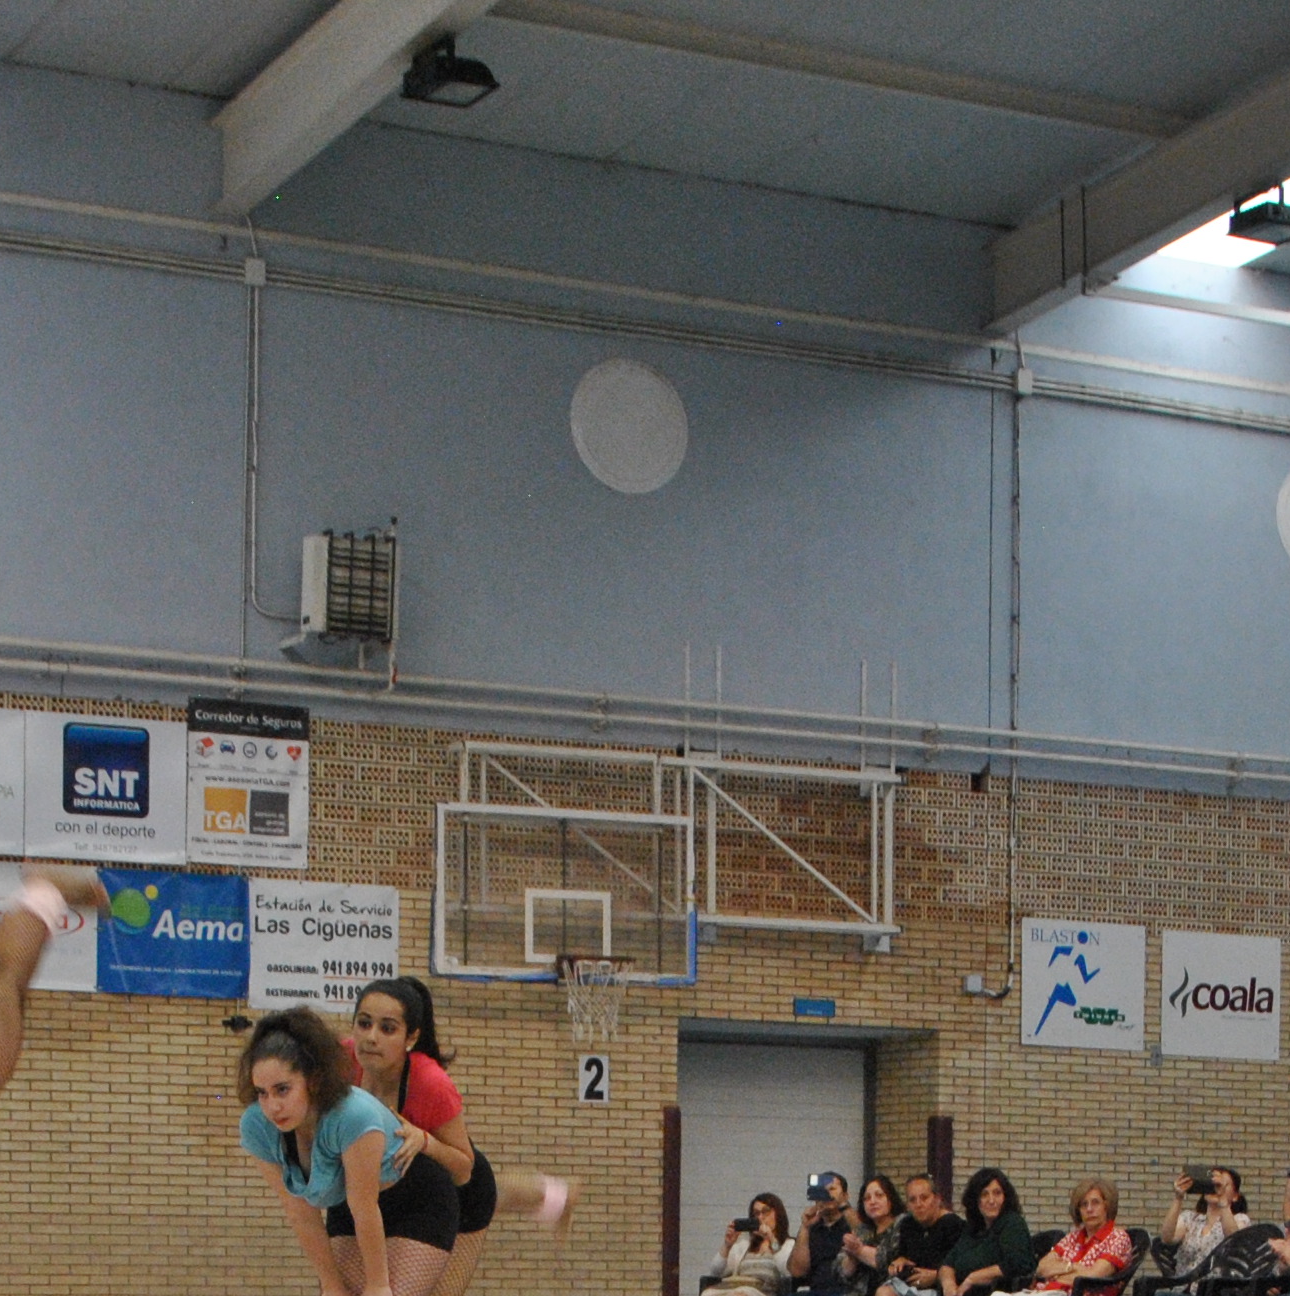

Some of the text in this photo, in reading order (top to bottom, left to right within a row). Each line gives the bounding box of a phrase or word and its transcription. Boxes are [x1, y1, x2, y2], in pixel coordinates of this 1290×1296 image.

[194, 709, 243, 724] Corredor
[246, 713, 259, 724] de
[262, 715, 303, 730] Seguros
[73, 767, 140, 798] SNT
[54, 820, 156, 840] con el deporte
[204, 810, 246, 831] TGA
[255, 894, 393, 917] Estación de Servicio
[152, 908, 245, 942] Aema
[254, 915, 393, 942] Las Cigüeñas
[1030, 926, 1101, 946] BLASTON
[266, 960, 394, 978] GASOLINERA: 941 894 994
[265, 987, 320, 999] RESTAURANTE:
[323, 983, 344, 1000] 941
[1191, 976, 1275, 1014] coala
[584, 1057, 604, 1100] 2
